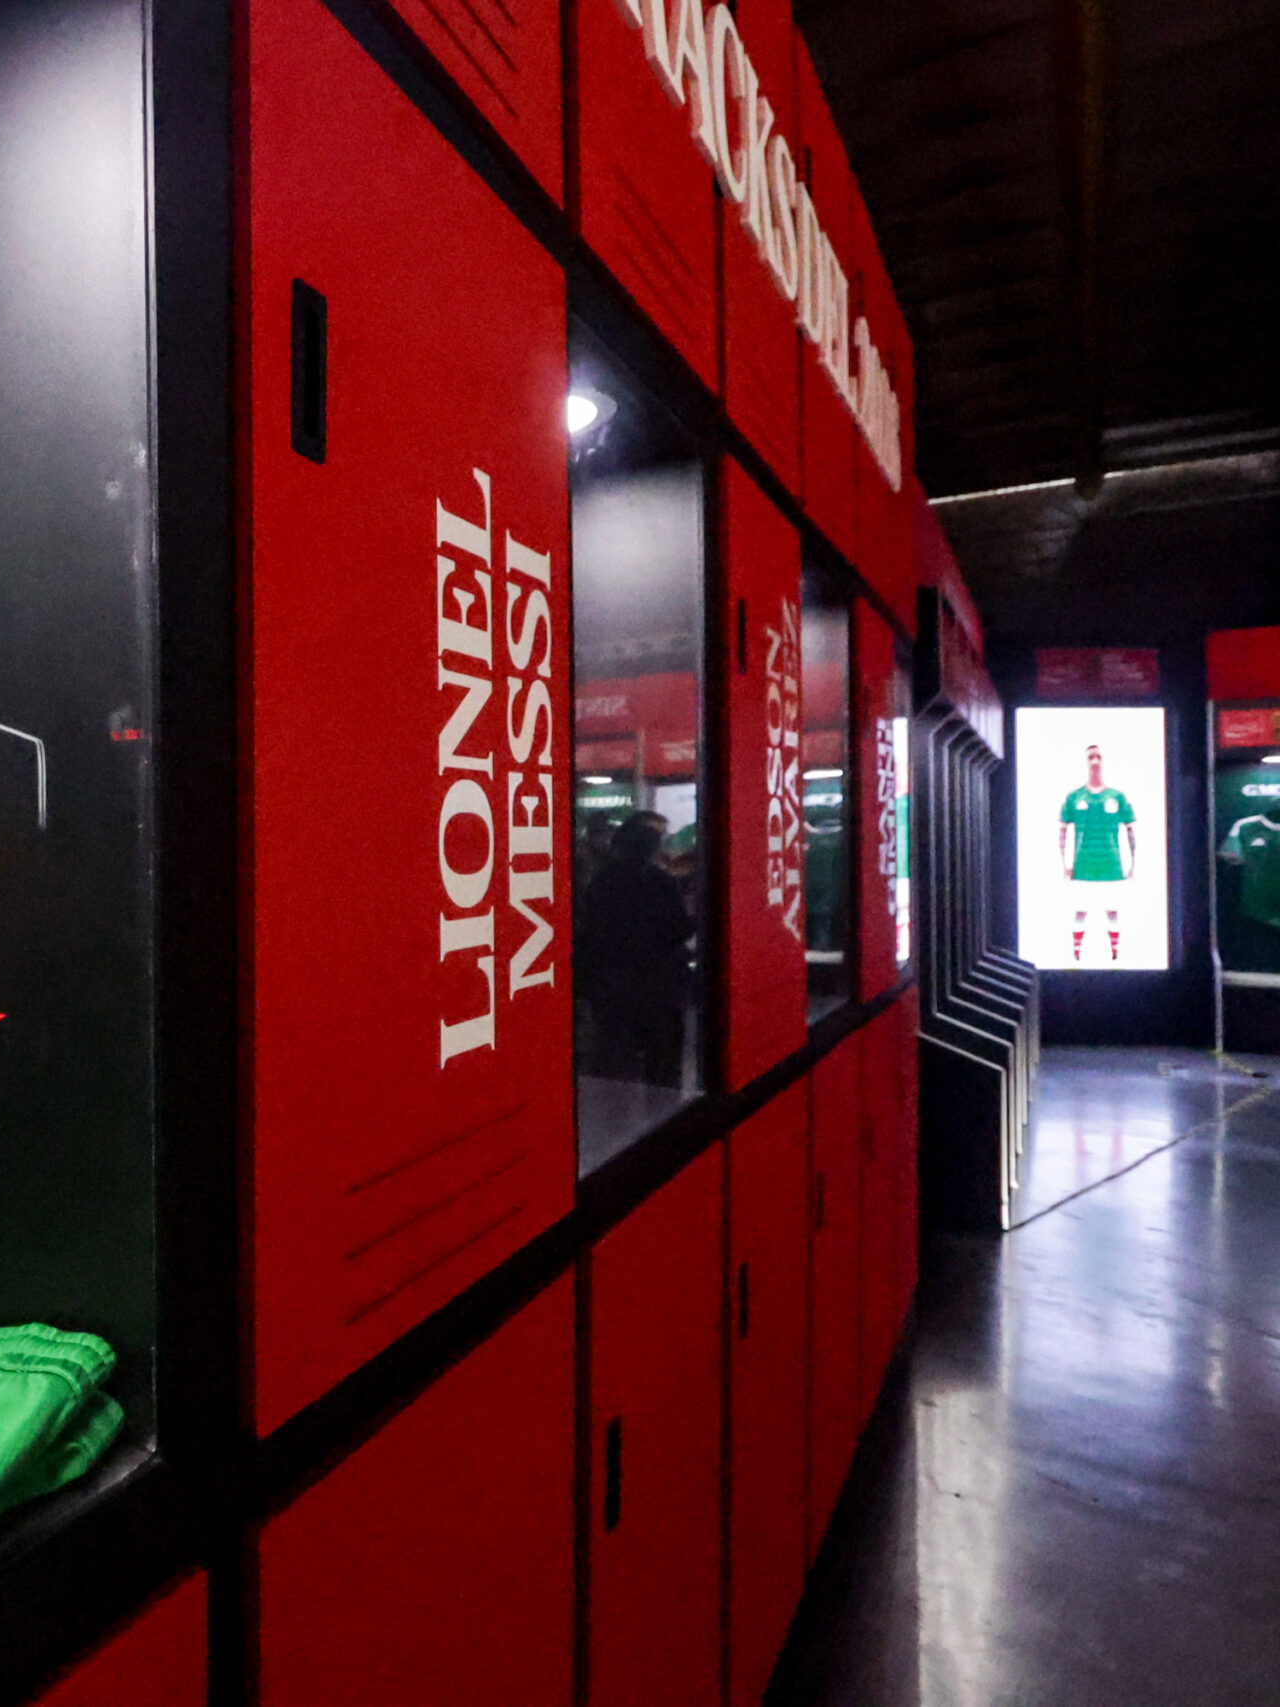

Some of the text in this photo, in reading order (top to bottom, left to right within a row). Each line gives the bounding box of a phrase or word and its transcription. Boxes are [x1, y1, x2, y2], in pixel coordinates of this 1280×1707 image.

[436, 468, 495, 1069] LIONEL
[506, 530, 554, 1000] MESSI
[767, 627, 782, 906] EDSON
